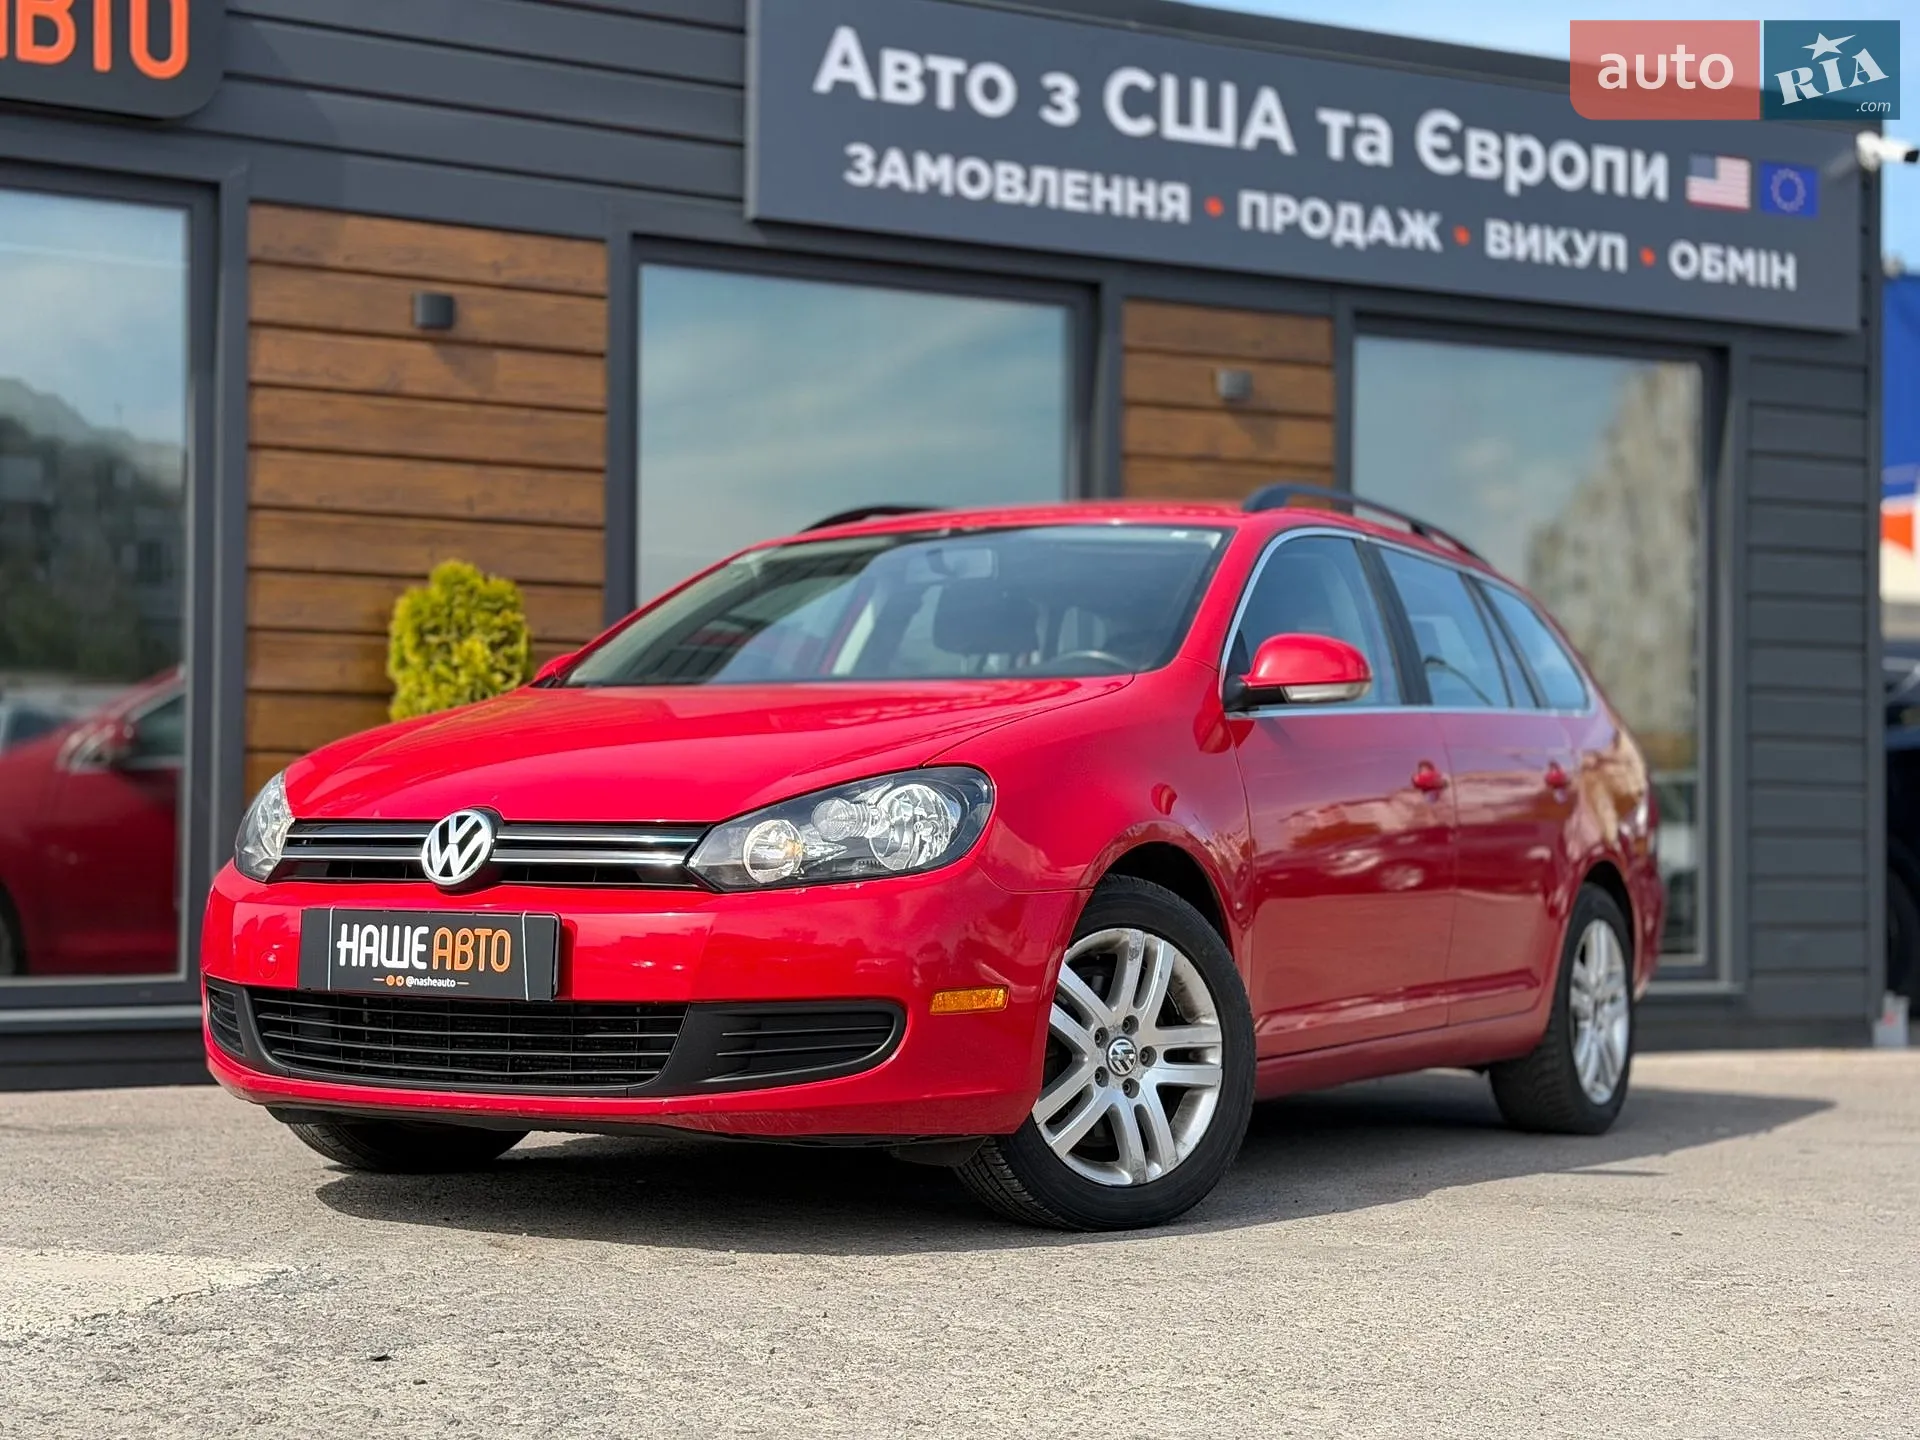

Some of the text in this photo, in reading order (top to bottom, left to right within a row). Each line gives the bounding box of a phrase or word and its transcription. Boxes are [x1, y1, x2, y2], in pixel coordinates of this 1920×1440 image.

[813, 25, 1670, 203] Авто з США та Європи
[843, 142, 1798, 292] ЗАМОВЛЕННЯ ПРОДАЖ ВИКУП ОБМІН
[405, 975, 456, 988] @nasheauto
